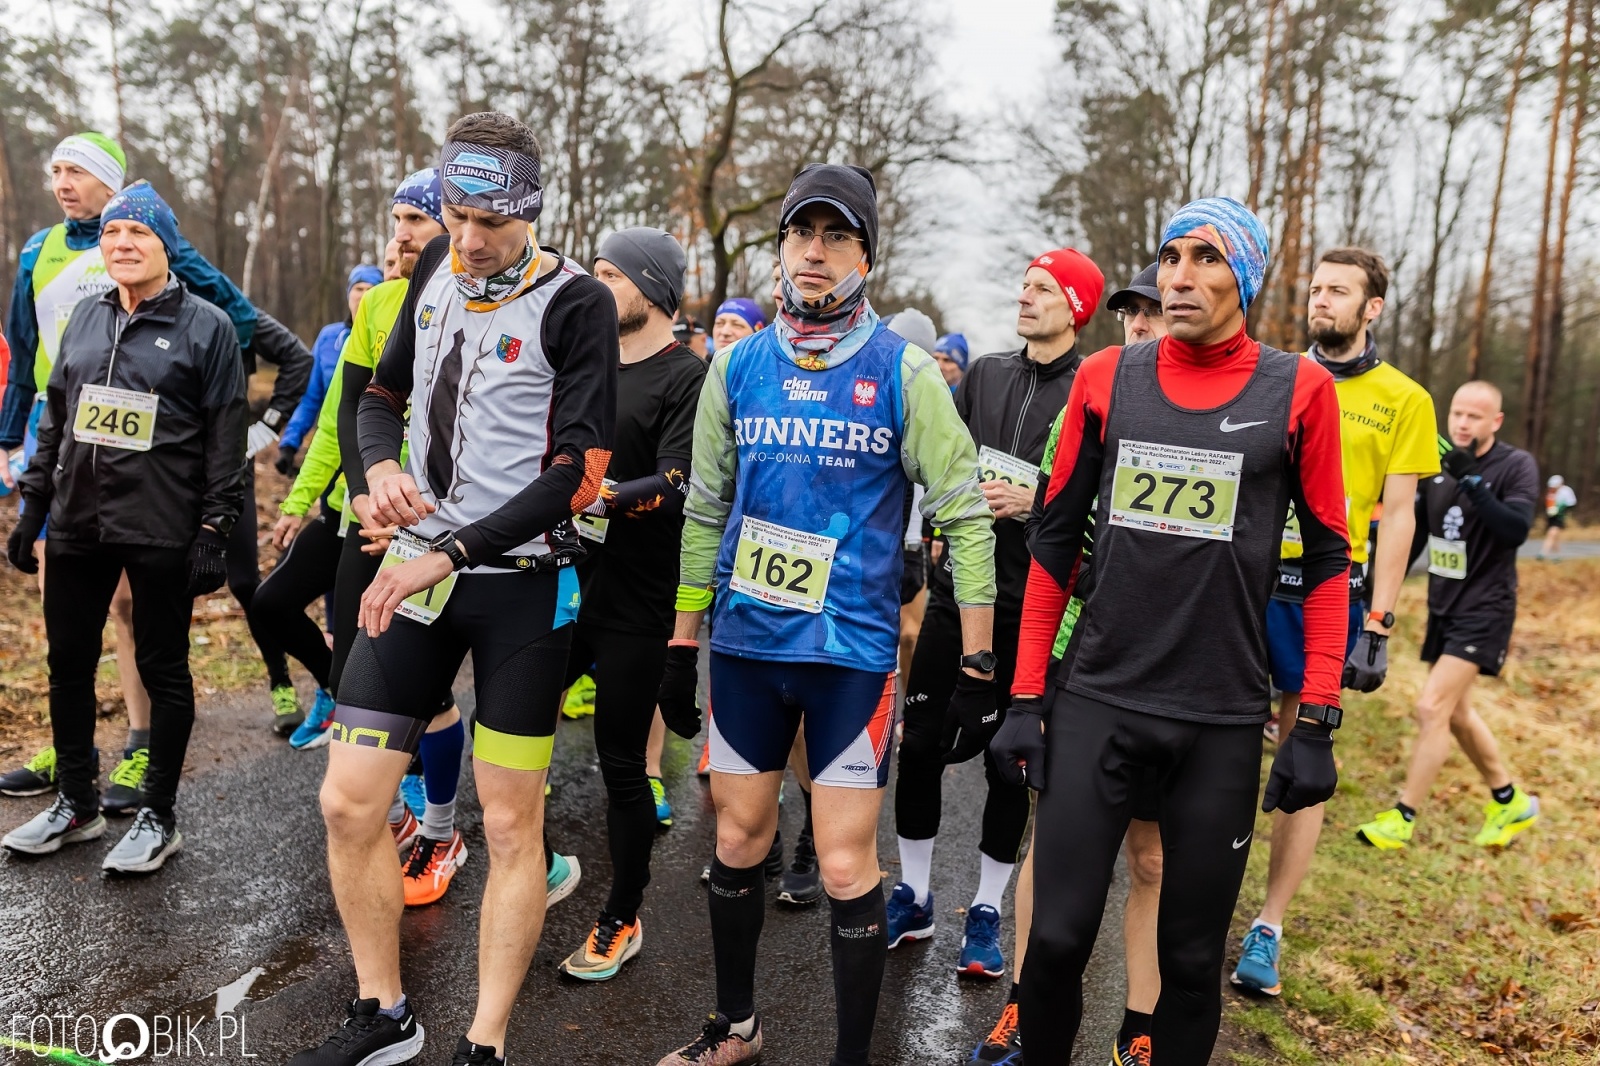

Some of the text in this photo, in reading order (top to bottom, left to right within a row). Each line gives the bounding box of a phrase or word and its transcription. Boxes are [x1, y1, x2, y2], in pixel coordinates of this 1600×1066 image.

[446, 165, 506, 187] ELIMINATOR
[492, 187, 543, 216] Super
[85, 405, 140, 436] 246
[1373, 403, 1397, 418] BIEG
[734, 417, 894, 455] RUNNERS
[817, 455, 856, 468] TEAM
[1208, 452, 1236, 461] RAFAMET
[1129, 472, 1216, 520] 273
[750, 547, 813, 594] 162
[1433, 550, 1459, 569] 219
[837, 925, 865, 934] DANISH
